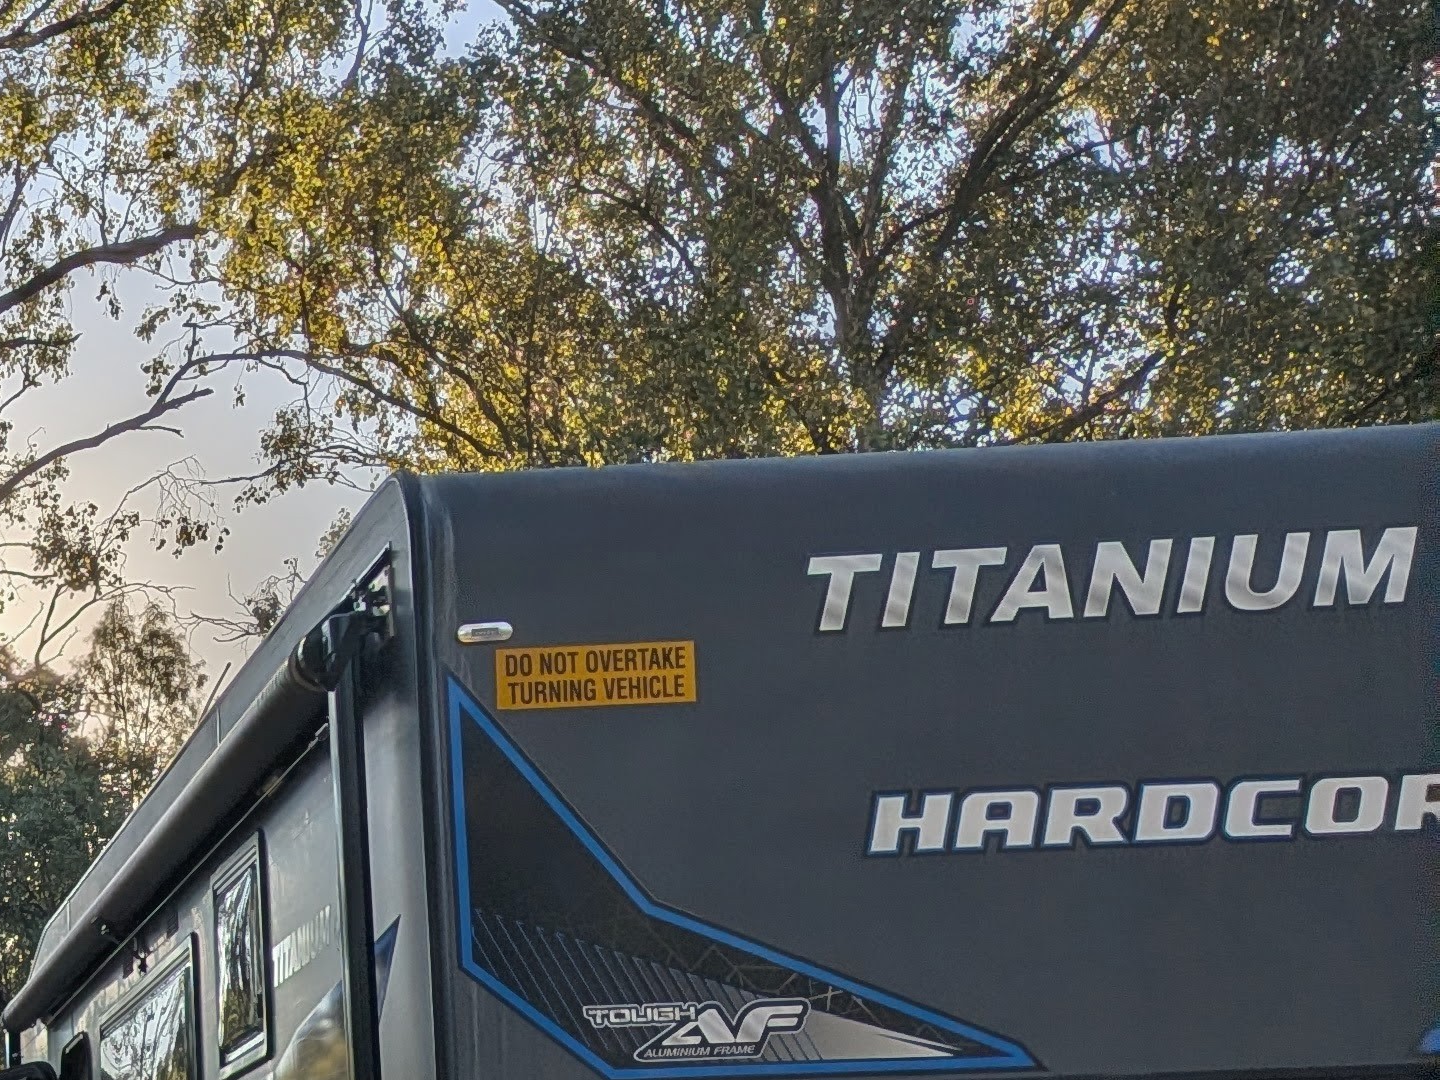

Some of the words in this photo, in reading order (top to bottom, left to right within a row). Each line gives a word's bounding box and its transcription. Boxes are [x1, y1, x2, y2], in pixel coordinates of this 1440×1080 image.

[807, 526, 1418, 631] TITANIUM
[505, 653, 532, 676] DO
[540, 651, 578, 675] NOT
[586, 646, 685, 672] OVERTAKE
[508, 679, 596, 704] TURNING
[603, 675, 685, 700] VEHICLE
[589, 1006, 696, 1024] TOUGH
[644, 1046, 710, 1057] ALUMINIUM
[713, 1045, 755, 1056] FRAME
